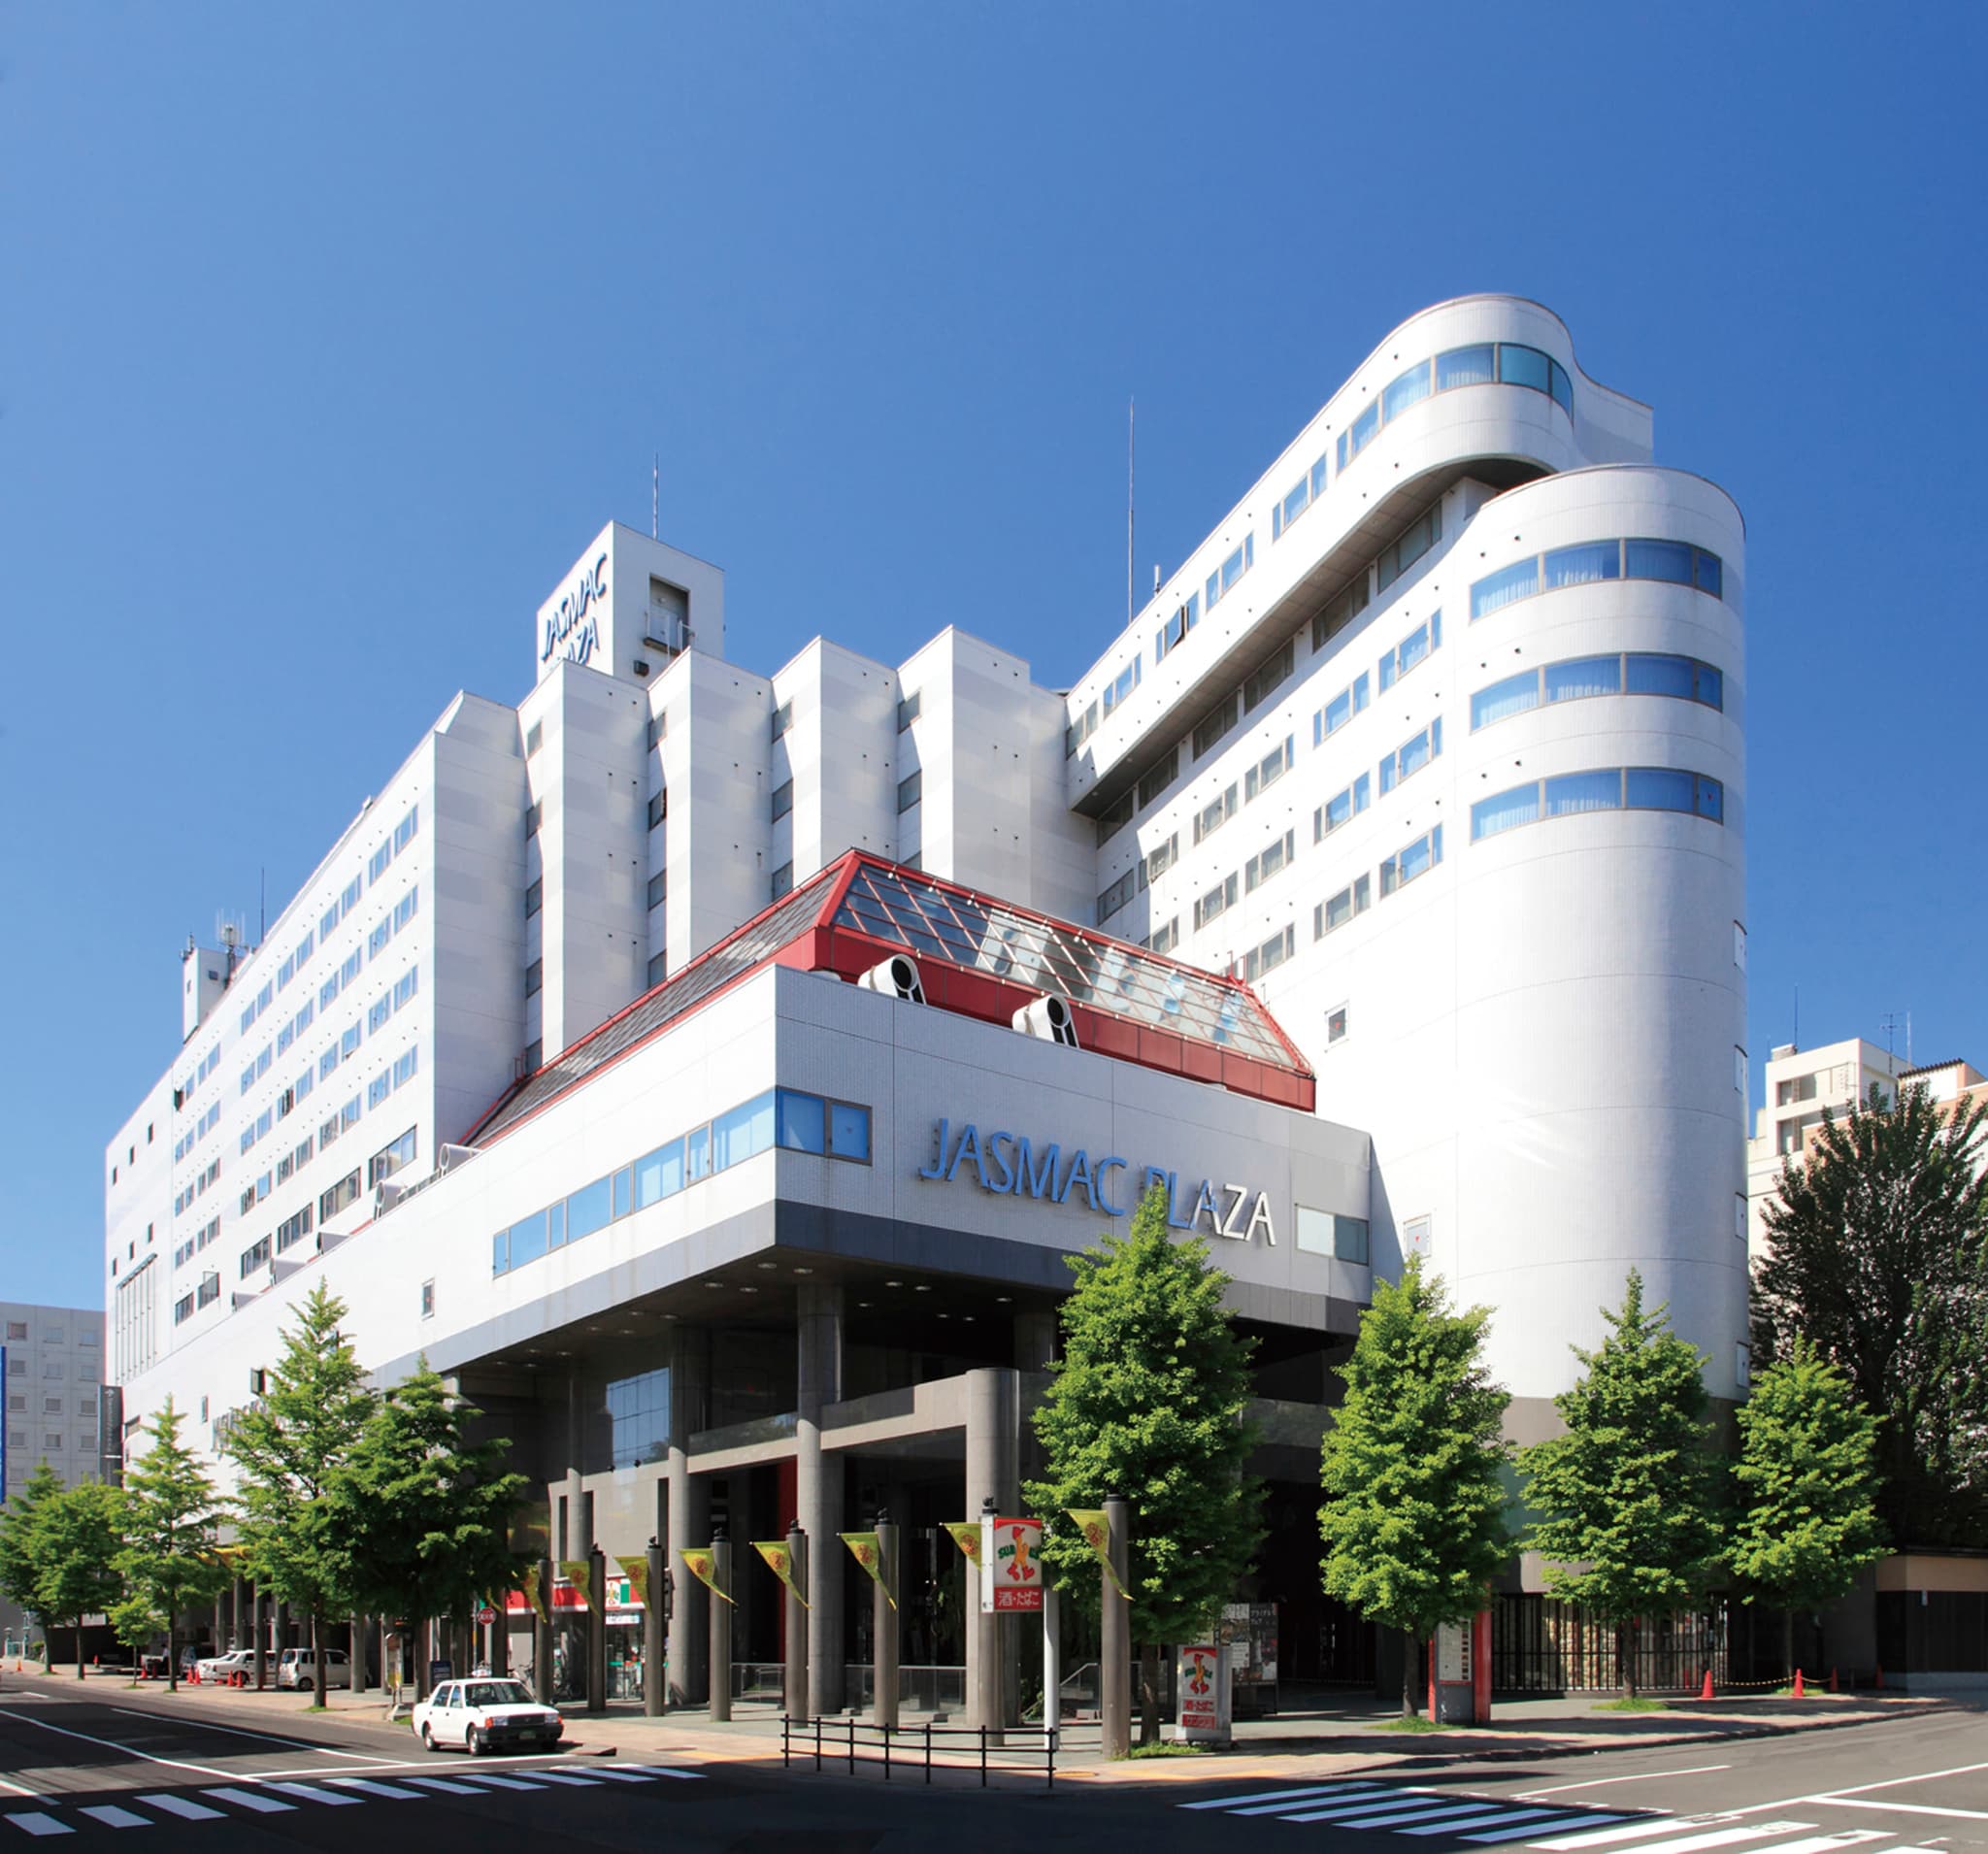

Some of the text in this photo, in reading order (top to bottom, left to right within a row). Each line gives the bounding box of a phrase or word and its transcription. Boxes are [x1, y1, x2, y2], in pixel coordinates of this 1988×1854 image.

[540, 551, 608, 663] JASMAC
[919, 1118, 1277, 1246] JASMAC PLAZA
